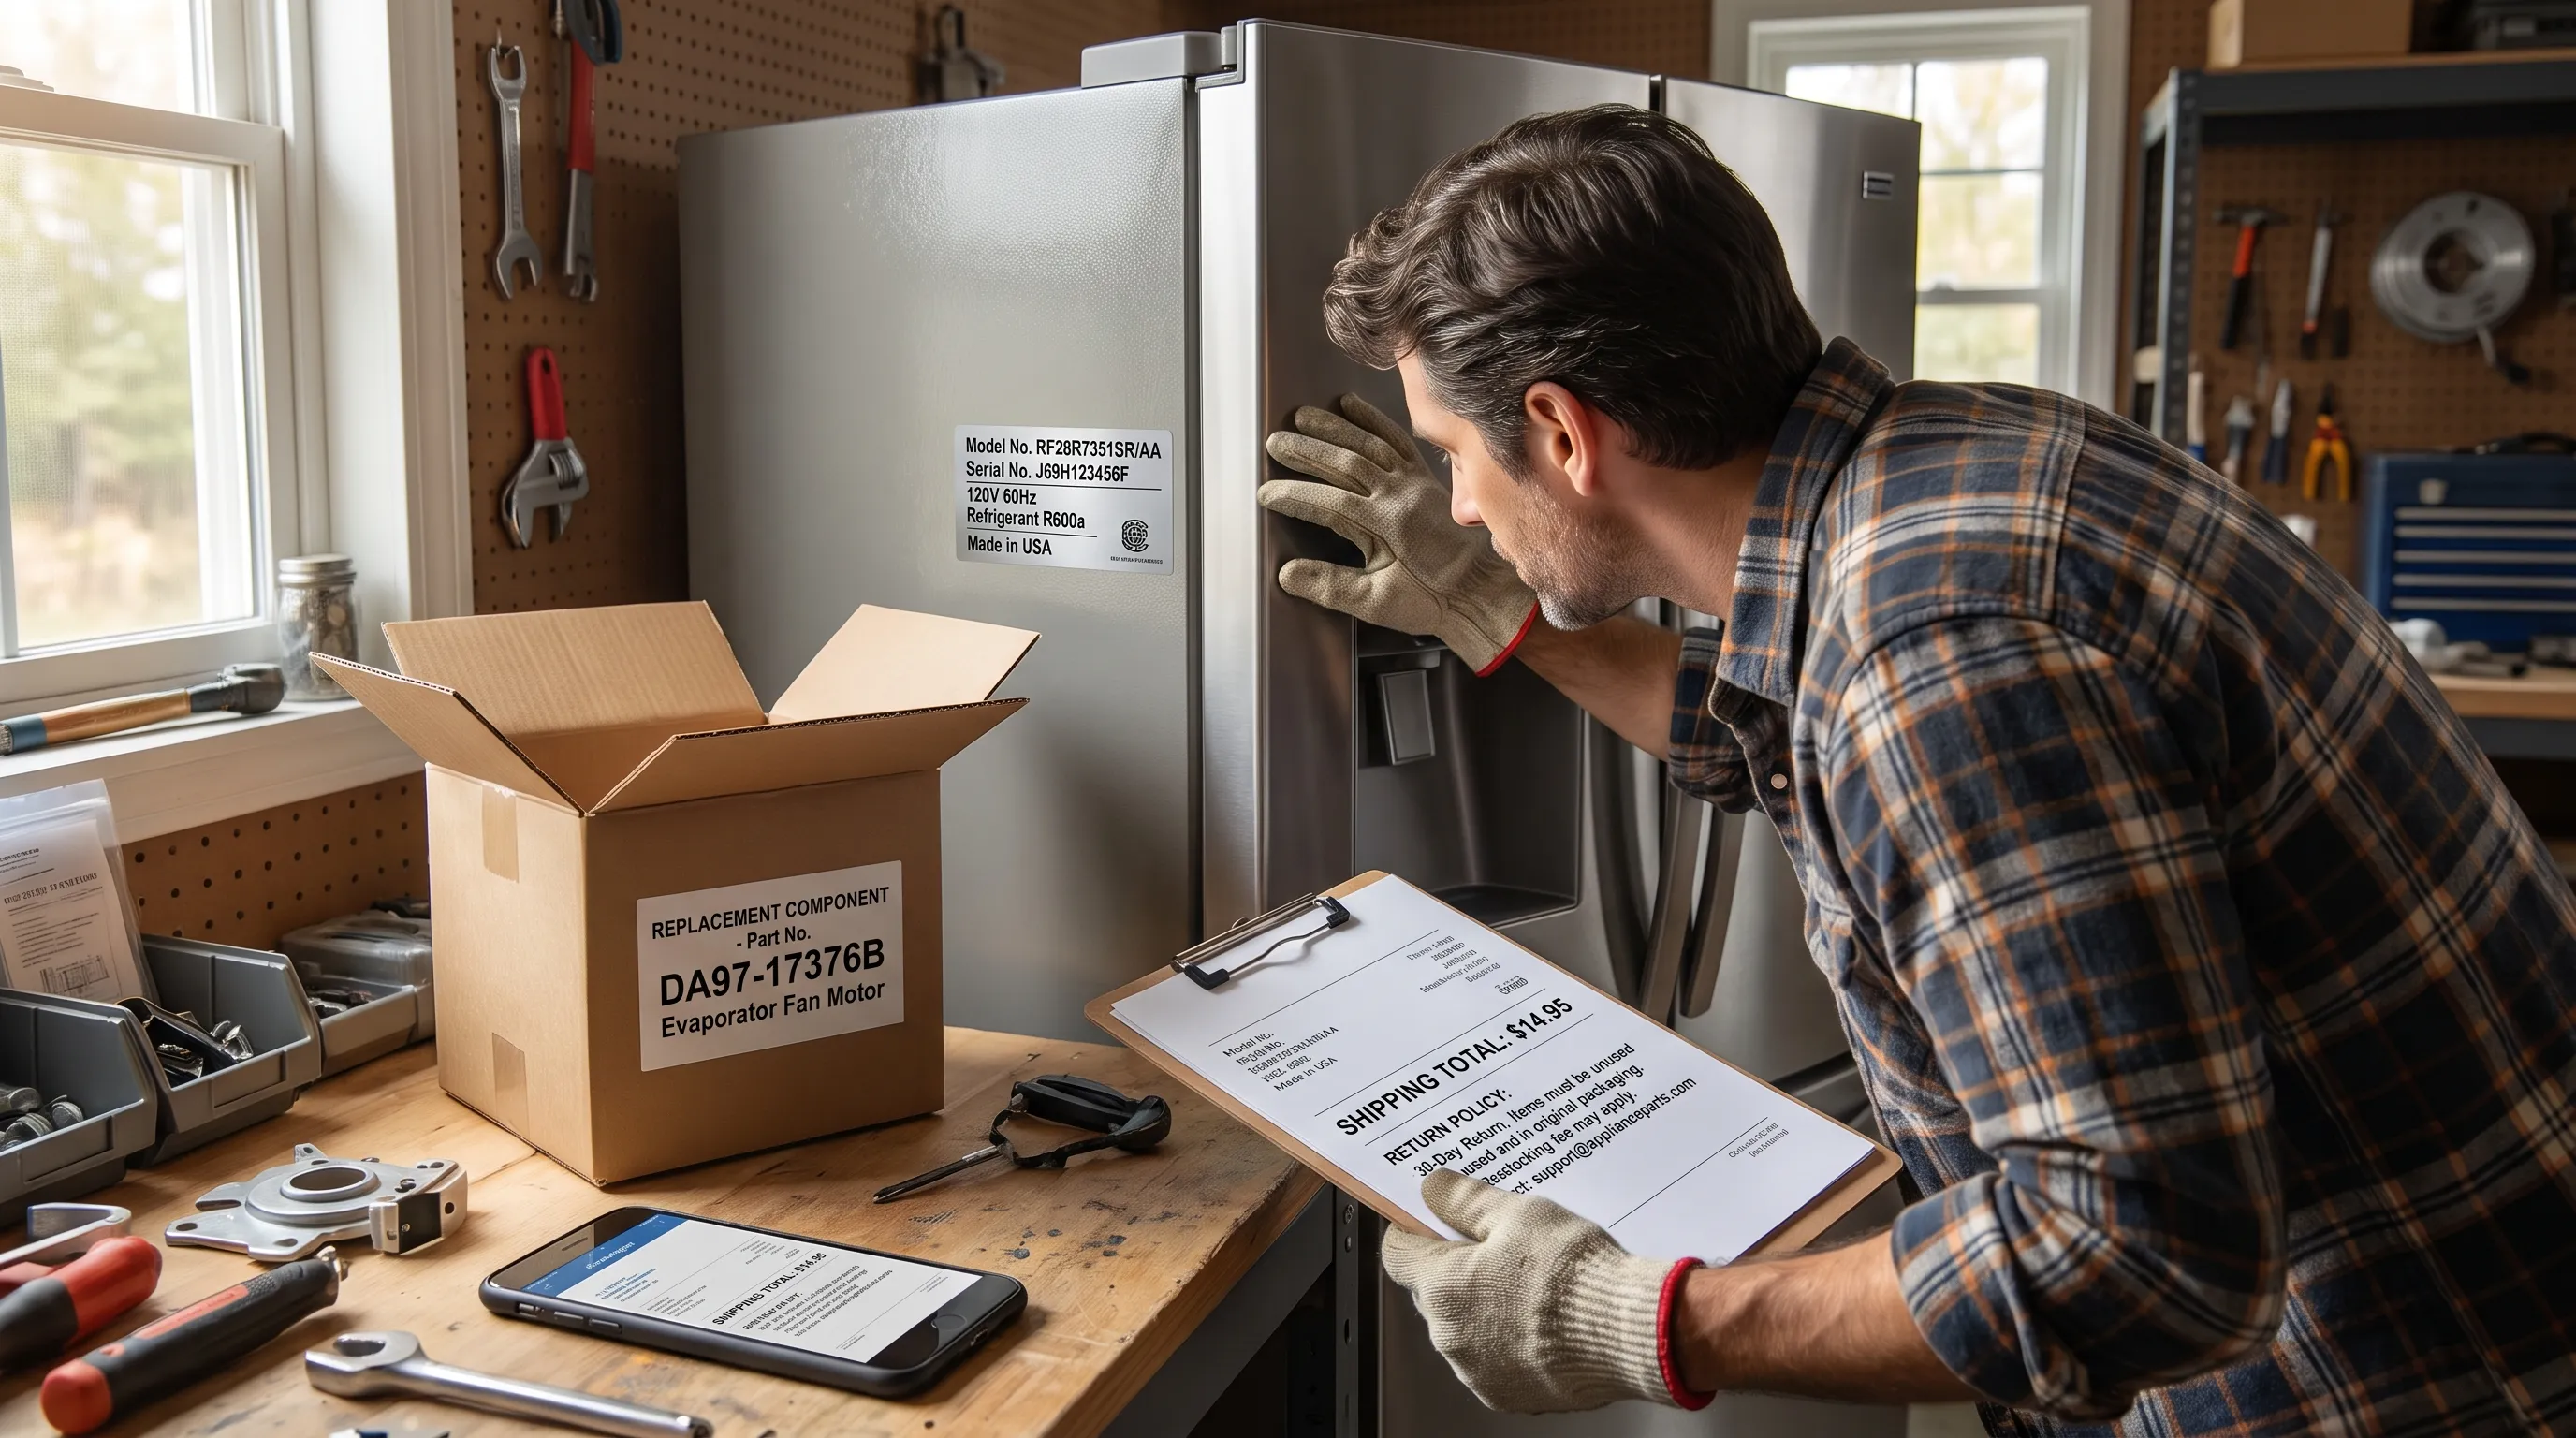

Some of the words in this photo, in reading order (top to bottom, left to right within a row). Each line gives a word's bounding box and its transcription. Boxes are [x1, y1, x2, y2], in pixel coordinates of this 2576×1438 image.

[966, 437, 1005, 454] Model
[1010, 439, 1032, 455] No.
[1036, 439, 1162, 459] RF28R7351SR/AA
[966, 461, 1004, 477] Serial
[1009, 462, 1032, 479] No.
[1035, 463, 1129, 482] J69H123456F
[966, 487, 1000, 503] 120V
[1003, 488, 1037, 505] 60Hz
[967, 506, 1039, 529] Refrigerant
[1043, 511, 1085, 529] R600a
[968, 535, 1003, 552] Made
[1006, 537, 1018, 554] in
[1023, 538, 1052, 555] USA
[652, 903, 781, 939] REPLACEMENT
[785, 887, 889, 917] COMPONENT
[747, 928, 780, 949] Part
[784, 926, 812, 944] No.
[661, 938, 885, 1006] DA97-17376B
[662, 1002, 778, 1038] Evaporator
[783, 994, 820, 1016] Fan
[827, 982, 885, 1007] Motor
[1314, 1056, 1339, 1071] USA
[1336, 1073, 1440, 1136] SHIPPING
[1432, 1034, 1513, 1078] TOTAL:
[1506, 997, 1573, 1039] $14.95
[1383, 1122, 1452, 1166] RETURN
[1447, 1088, 1513, 1128] POLICY:
[1413, 1146, 1463, 1177] 30-Day
[1506, 1097, 1545, 1123] Items
[1544, 1078, 1576, 1102] must
[1571, 1070, 1591, 1084] be
[1589, 1043, 1635, 1074] unused
[1496, 1135, 1521, 1155] and
[1515, 1127, 1535, 1141] in
[1533, 1099, 1579, 1133] original
[1576, 1064, 1645, 1107] packaging.
[1531, 1078, 1697, 1184] support@applianceparts.com
[1550, 1128, 1574, 1145] fee
[1573, 1111, 1602, 1133] may
[1600, 1089, 1638, 1116] apply.
